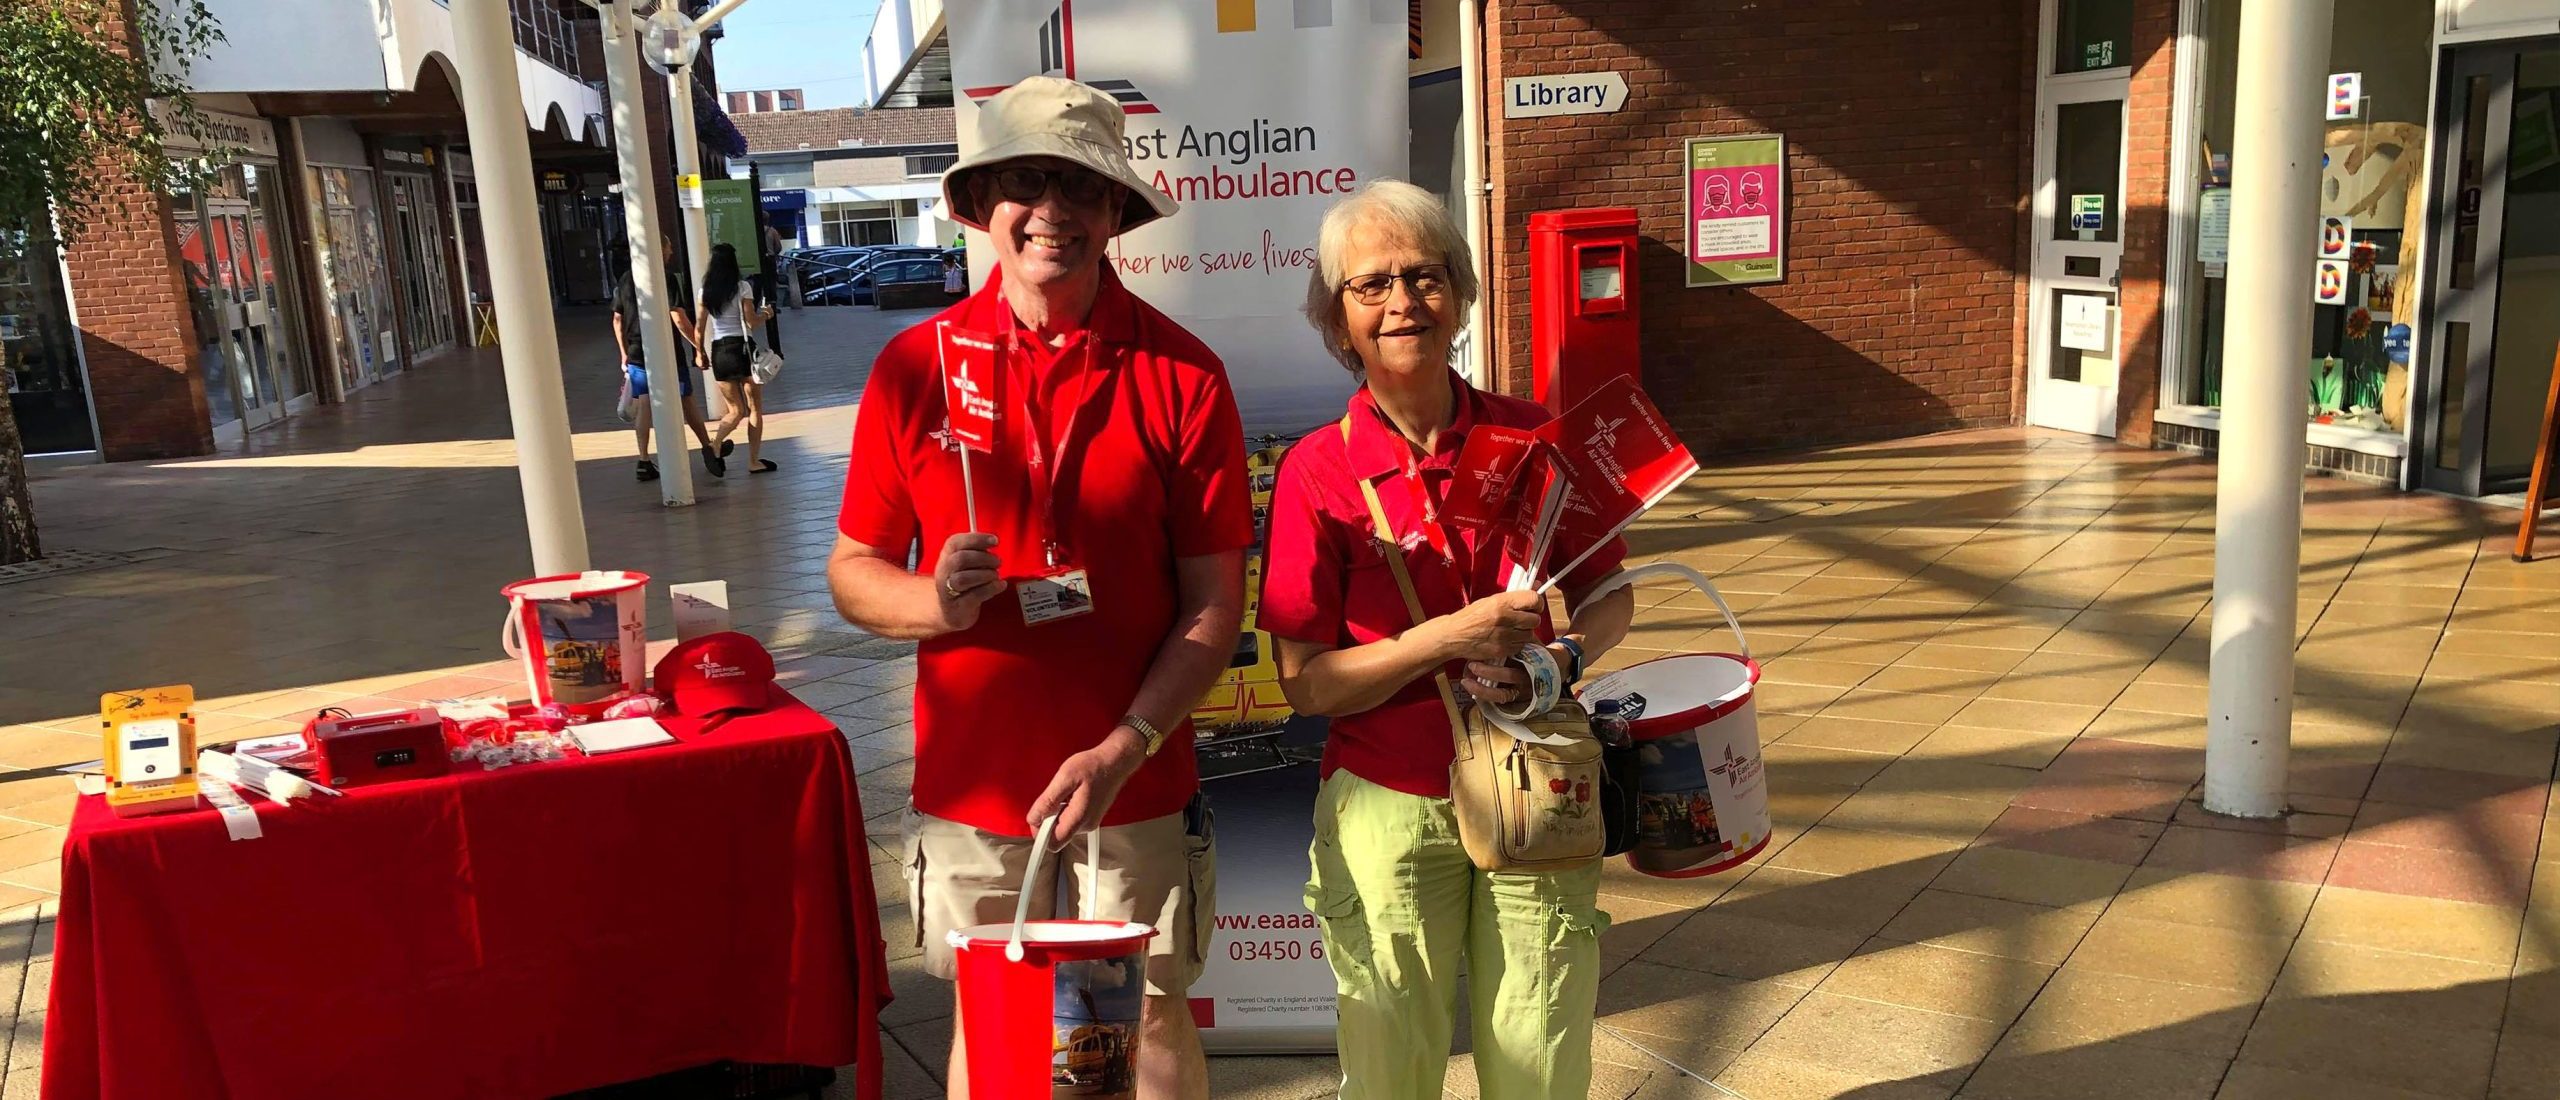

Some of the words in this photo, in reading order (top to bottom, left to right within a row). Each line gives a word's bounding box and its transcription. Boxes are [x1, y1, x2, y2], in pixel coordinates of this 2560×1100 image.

[2087, 44, 2100, 54] FIRE
[2086, 57, 2100, 67] EXIT
[1515, 83, 1608, 107] Library
[2334, 76, 2352, 115] E
[1123, 128, 1168, 161] ast
[1176, 118, 1316, 165] Anglian
[543, 180, 568, 190] HILL
[1152, 162, 1356, 202] Ambulance
[2324, 217, 2345, 255] D
[1162, 251, 1193, 275] we
[1200, 249, 1256, 274] save
[1262, 229, 1316, 276] lives
[2320, 263, 2341, 300] D
[1629, 392, 1649, 419] Together
[1645, 414, 1654, 426] we
[1652, 421, 1663, 438] save
[1660, 435, 1675, 453] lives
[1490, 433, 1515, 444] Together
[1587, 449, 1598, 460] Air
[1594, 458, 1625, 495] Ambulance
[1595, 441, 1609, 458] East
[1605, 454, 1627, 482] Anglian
[1026, 602, 1060, 613] VOLUNTEER
[1618, 699, 1643, 717] EAL
[1214, 913, 1321, 930] ww.eaaa.
[1229, 940, 1302, 961] 03450
[1310, 940, 1323, 960] 6
[1257, 996, 1277, 1004] Charity
[1283, 996, 1308, 1004] England
[1267, 1005, 1287, 1013] Charity
